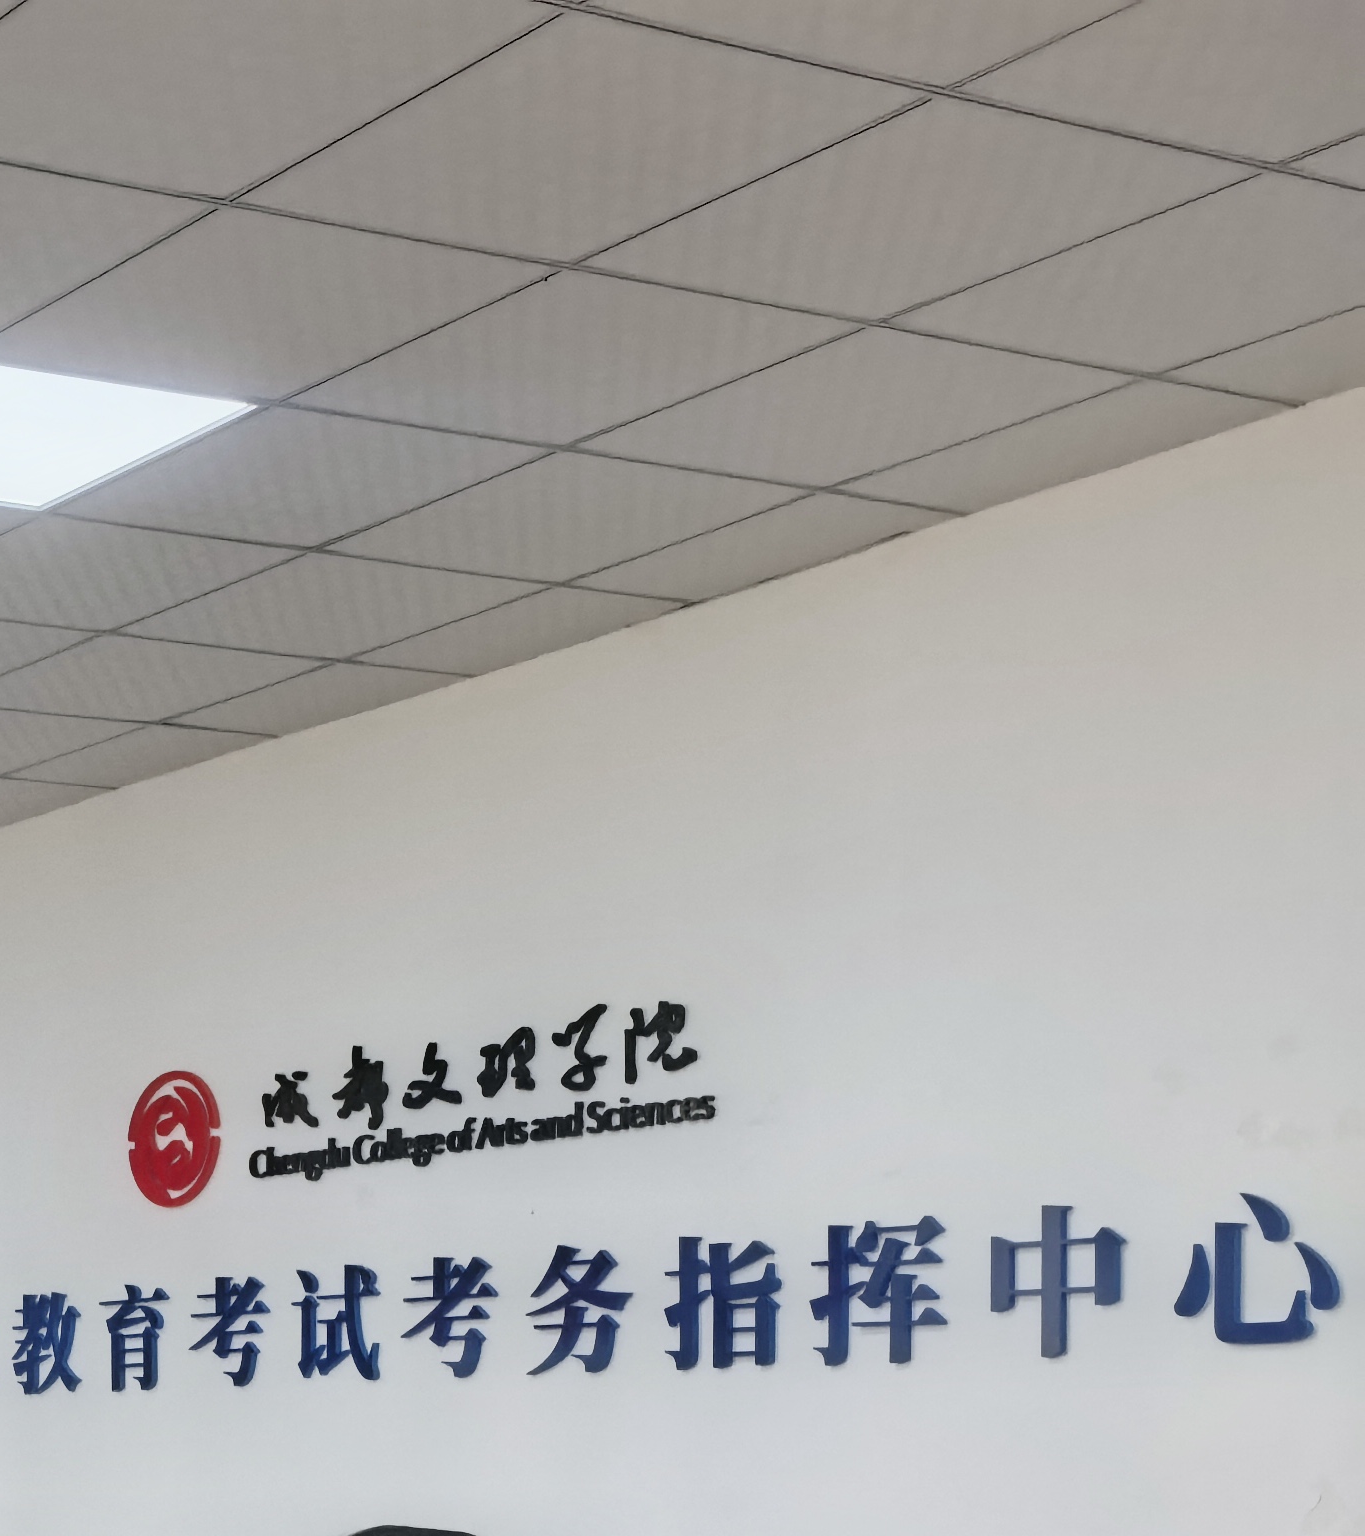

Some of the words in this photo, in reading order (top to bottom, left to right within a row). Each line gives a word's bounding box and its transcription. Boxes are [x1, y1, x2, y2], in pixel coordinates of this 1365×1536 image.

[261, 1000, 699, 1130] 成都文理学院
[248, 1137, 351, 1181] Chengdu
[352, 1127, 446, 1167] College
[446, 1116, 477, 1152] of
[475, 1117, 529, 1150] Arts
[530, 1101, 585, 1142] and
[586, 1095, 717, 1134] Sciences
